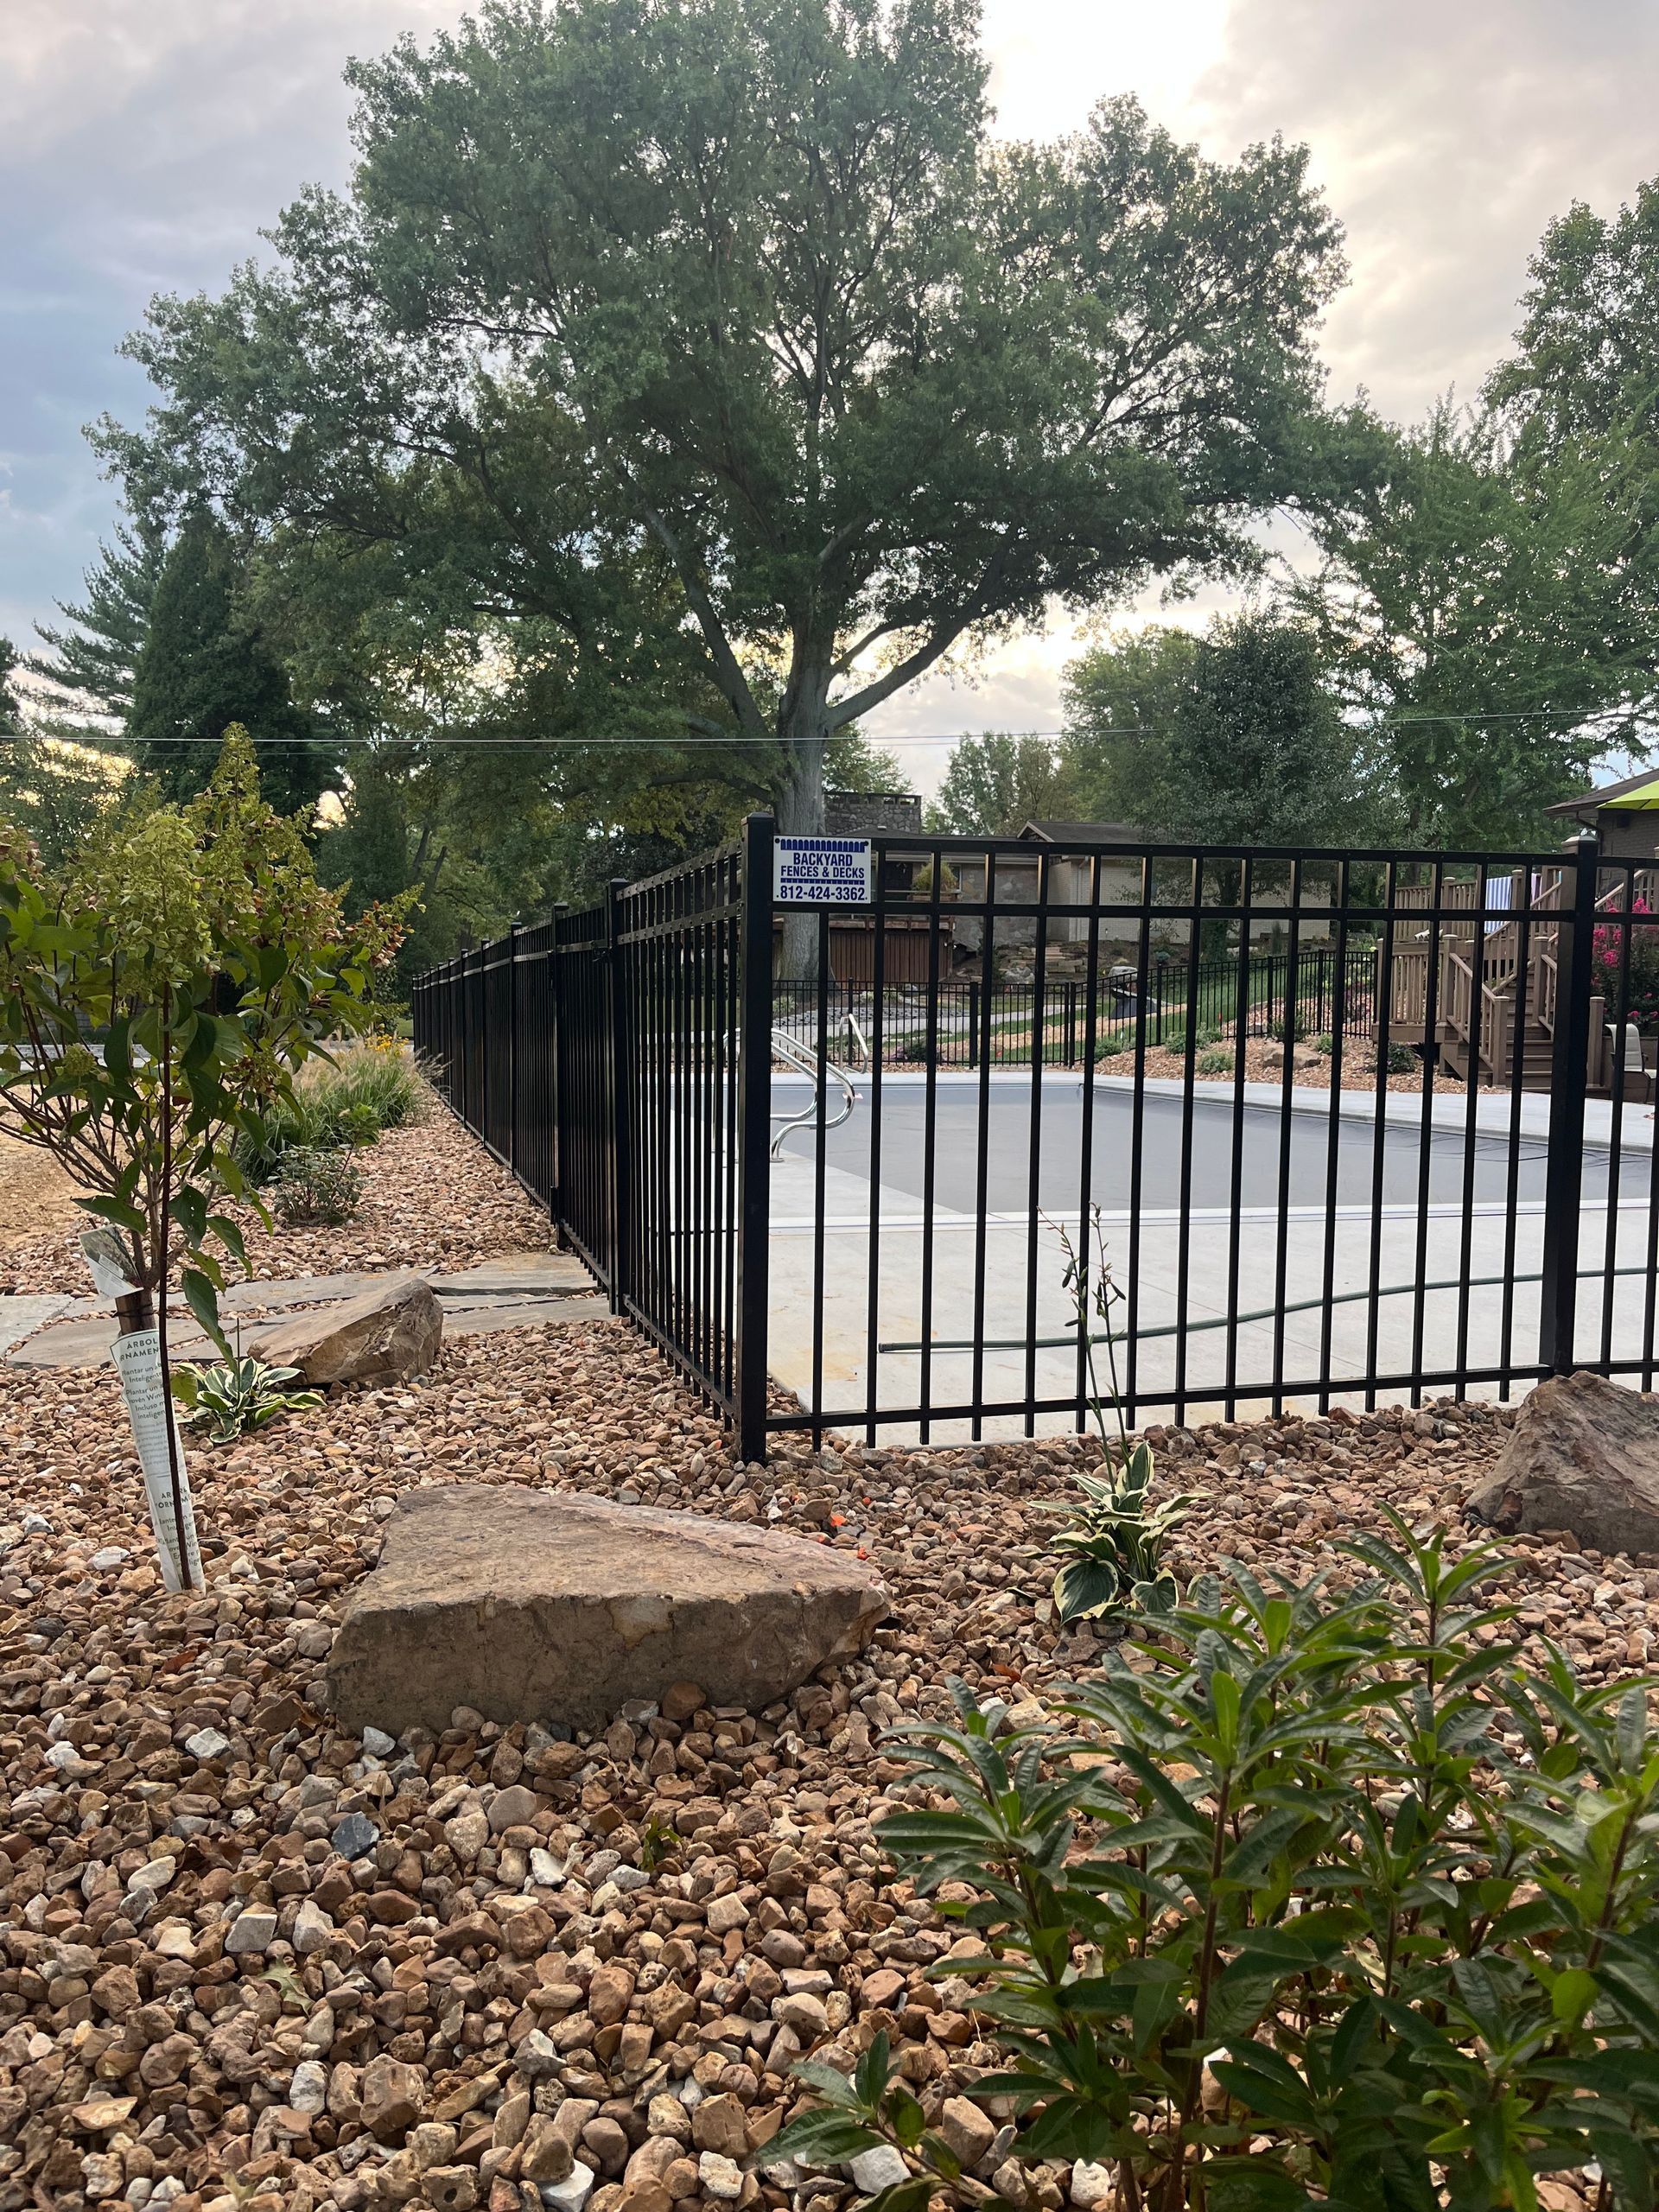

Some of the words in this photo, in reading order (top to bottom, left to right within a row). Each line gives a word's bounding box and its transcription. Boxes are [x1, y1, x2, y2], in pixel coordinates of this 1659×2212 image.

[793, 852, 853, 867] BACKYARD
[780, 865, 819, 878] FENCES
[822, 866, 830, 878] &
[833, 867, 865, 879] DECKS
[780, 885, 865, 900] 812-424-3362
[126, 1338, 158, 1350] ÁRBOL
[119, 1346, 159, 1362] RNAMEN
[137, 1409, 165, 1420] inteligen
